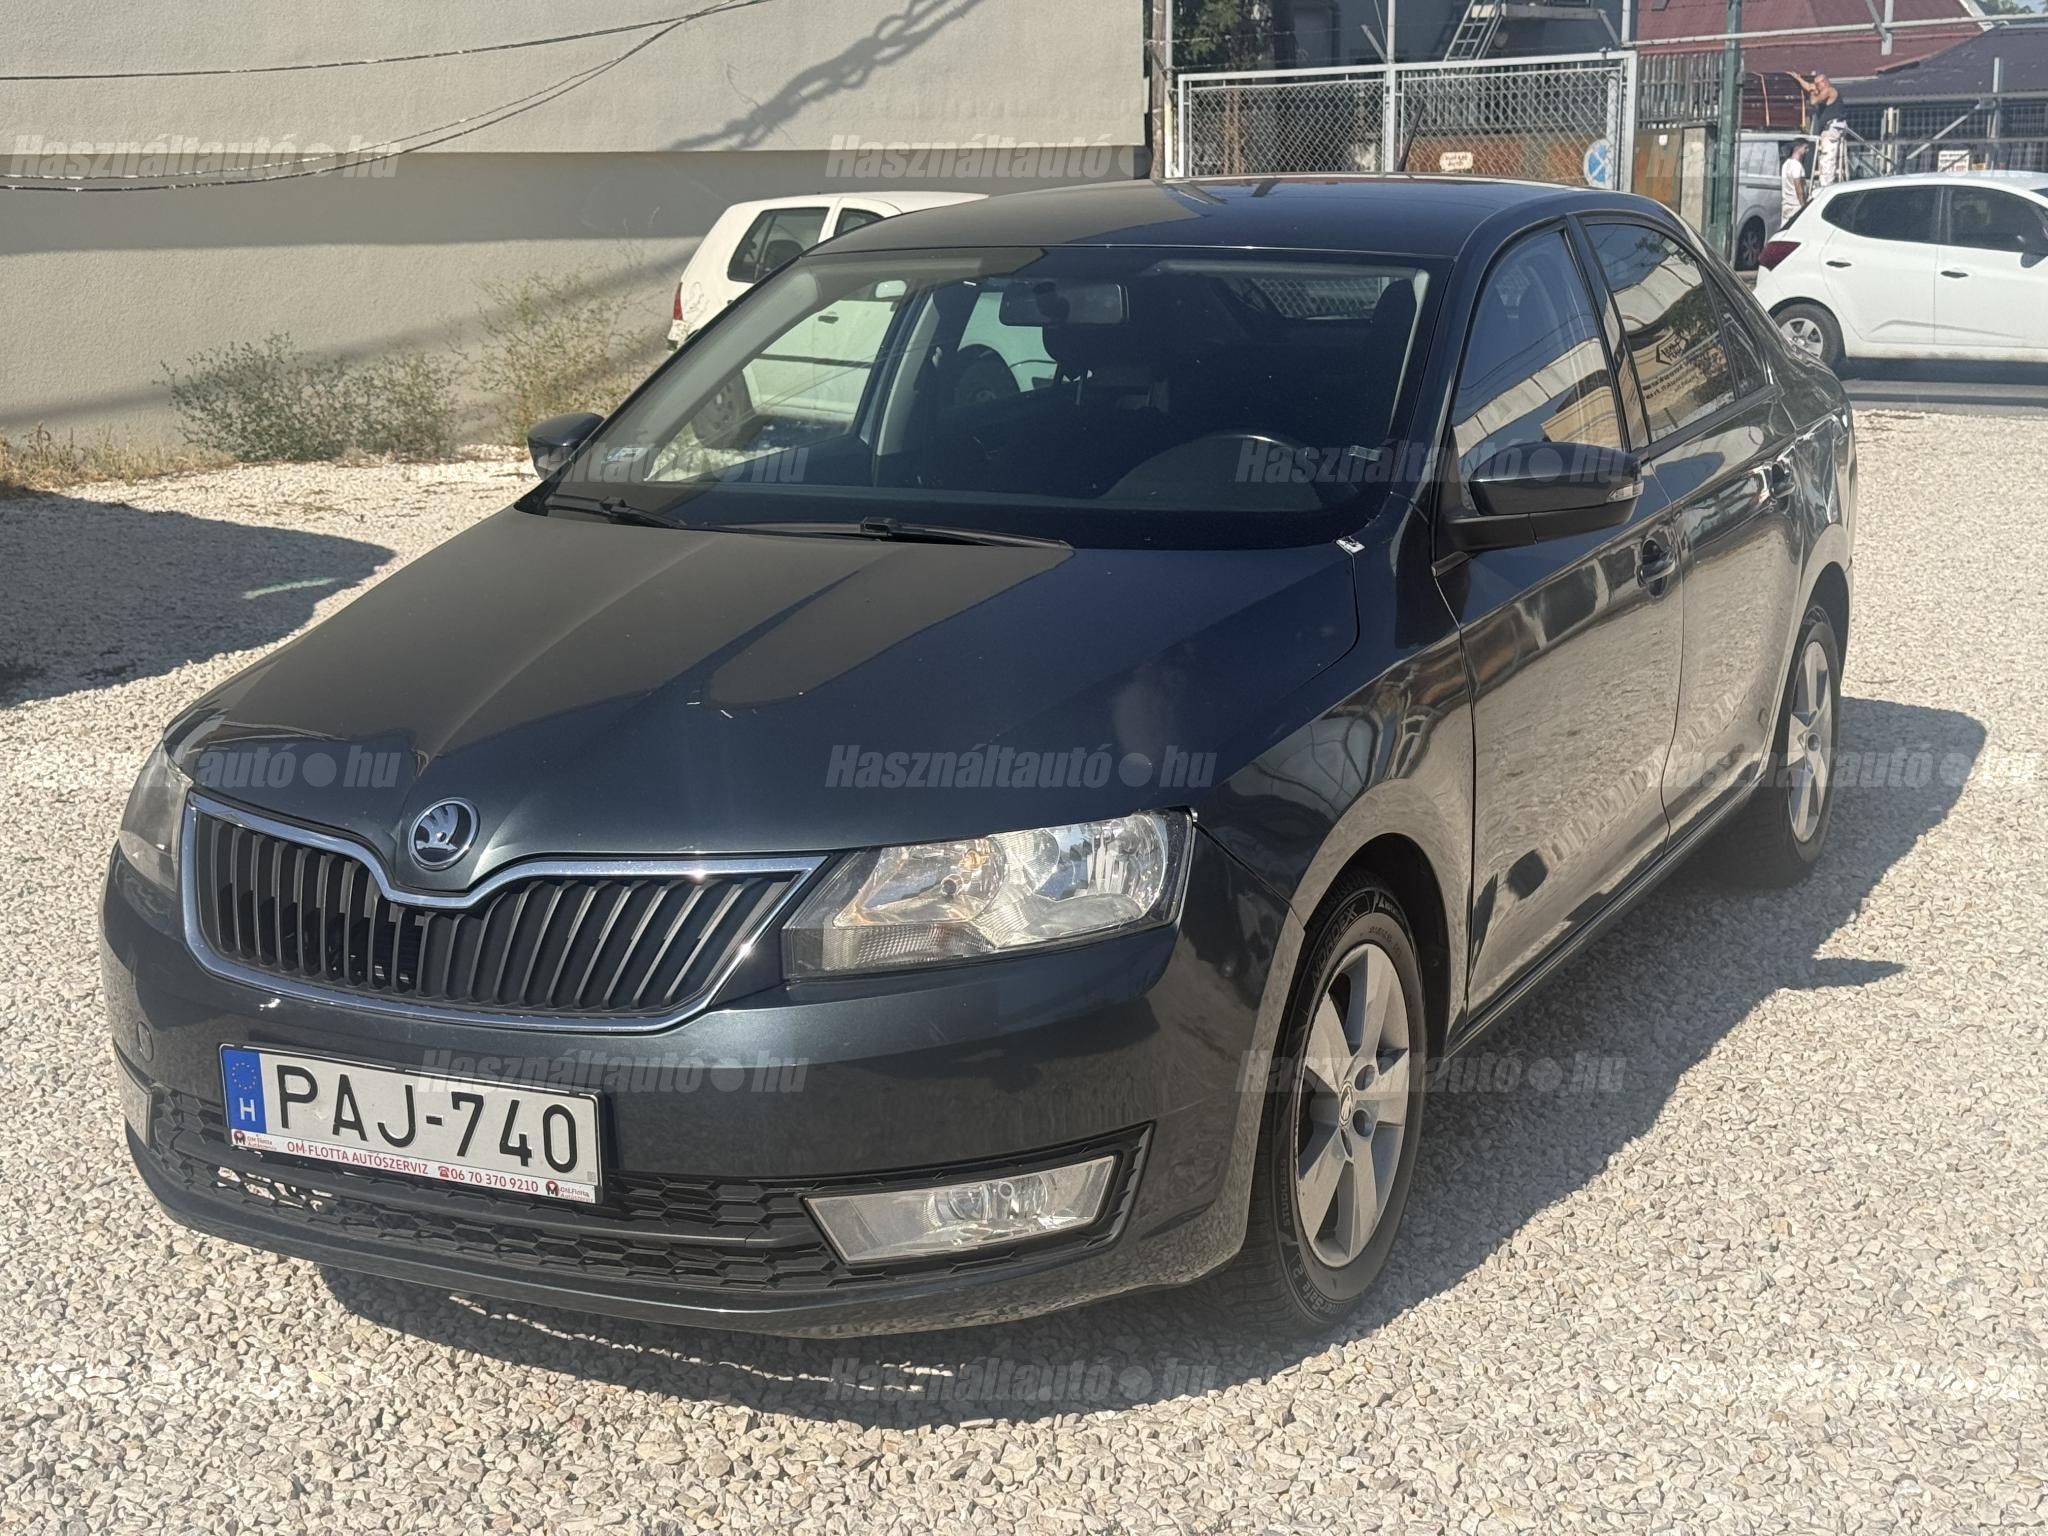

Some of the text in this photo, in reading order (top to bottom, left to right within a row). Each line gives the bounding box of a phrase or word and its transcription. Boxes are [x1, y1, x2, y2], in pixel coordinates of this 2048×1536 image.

[239, 1097, 256, 1122] H
[276, 1064, 577, 1174] PAJ-740
[308, 1144, 349, 1162] FLOTTA
[352, 1152, 429, 1175] AUTÓSZERVIZ
[450, 1168, 465, 1181] 06
[468, 1171, 482, 1183] 70
[486, 1173, 507, 1187] 370
[509, 1177, 539, 1193] 9210
